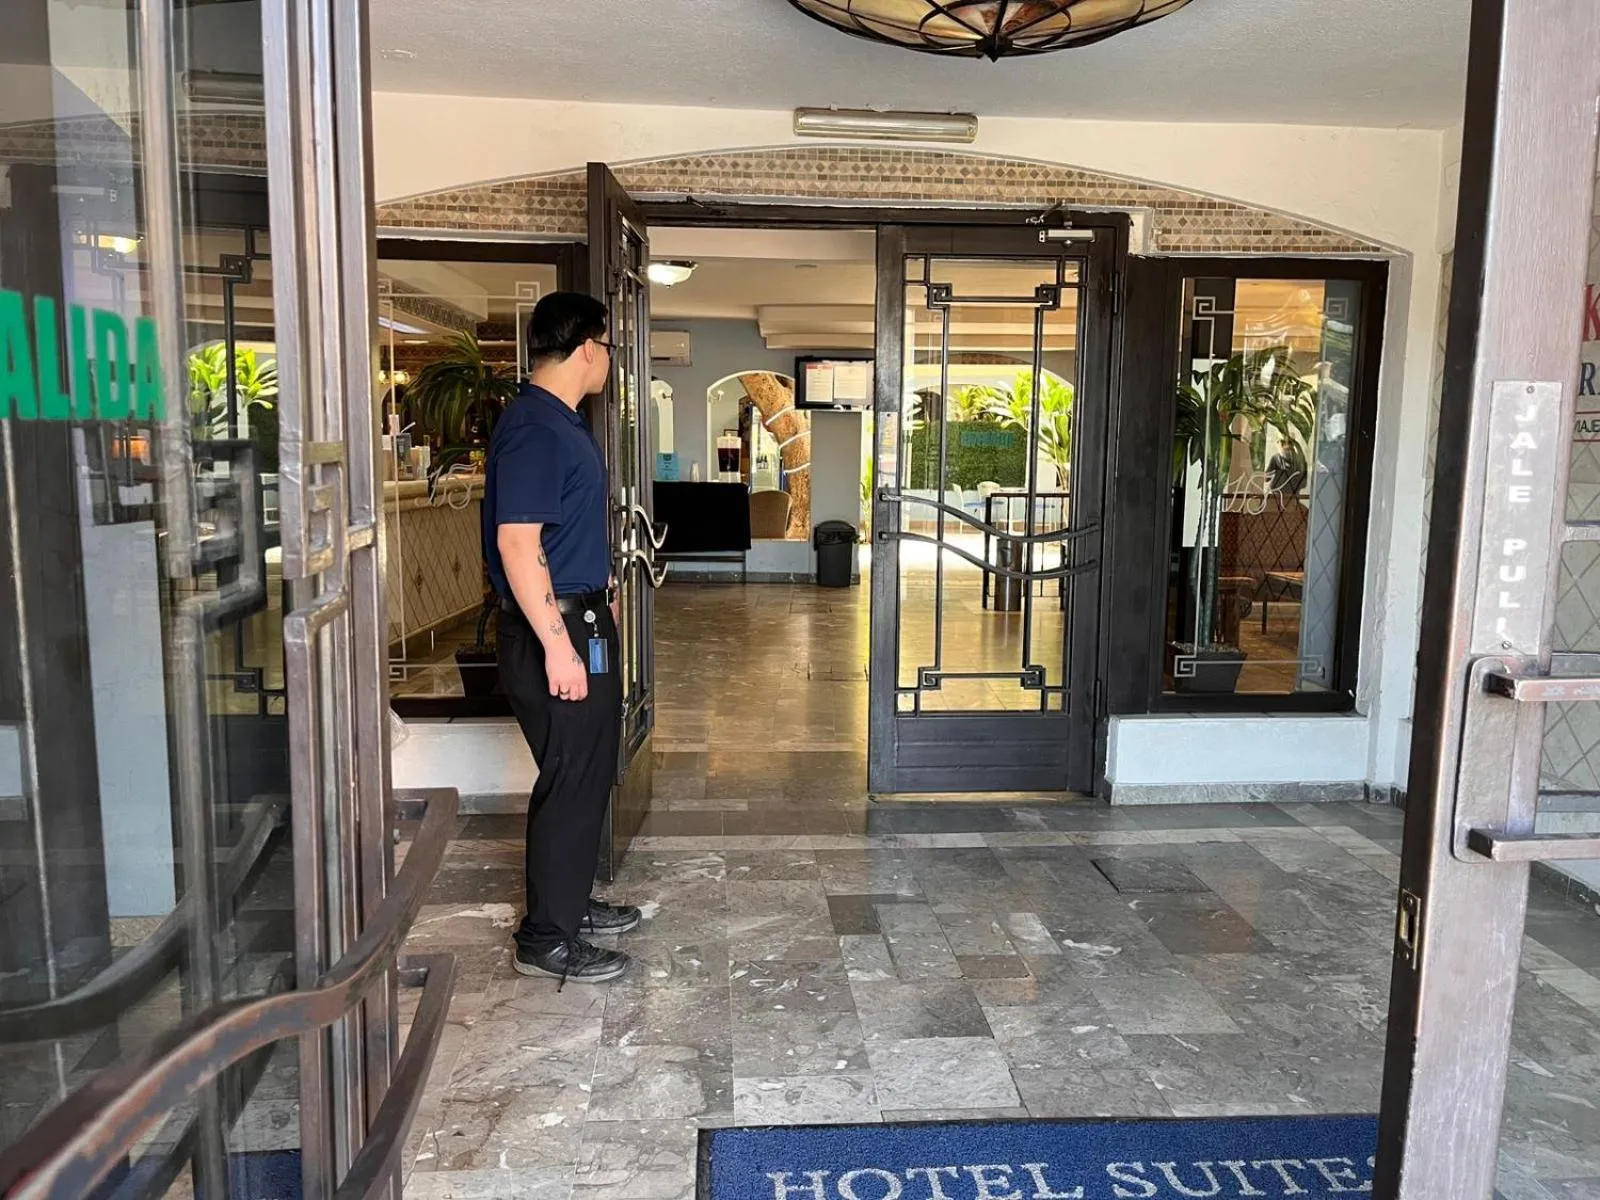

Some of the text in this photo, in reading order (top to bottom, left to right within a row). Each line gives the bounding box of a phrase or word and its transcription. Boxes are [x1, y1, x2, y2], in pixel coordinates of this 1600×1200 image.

[1509, 404, 1538, 503] JALE
[766, 1155, 1376, 1200] HOTEL SUITE
